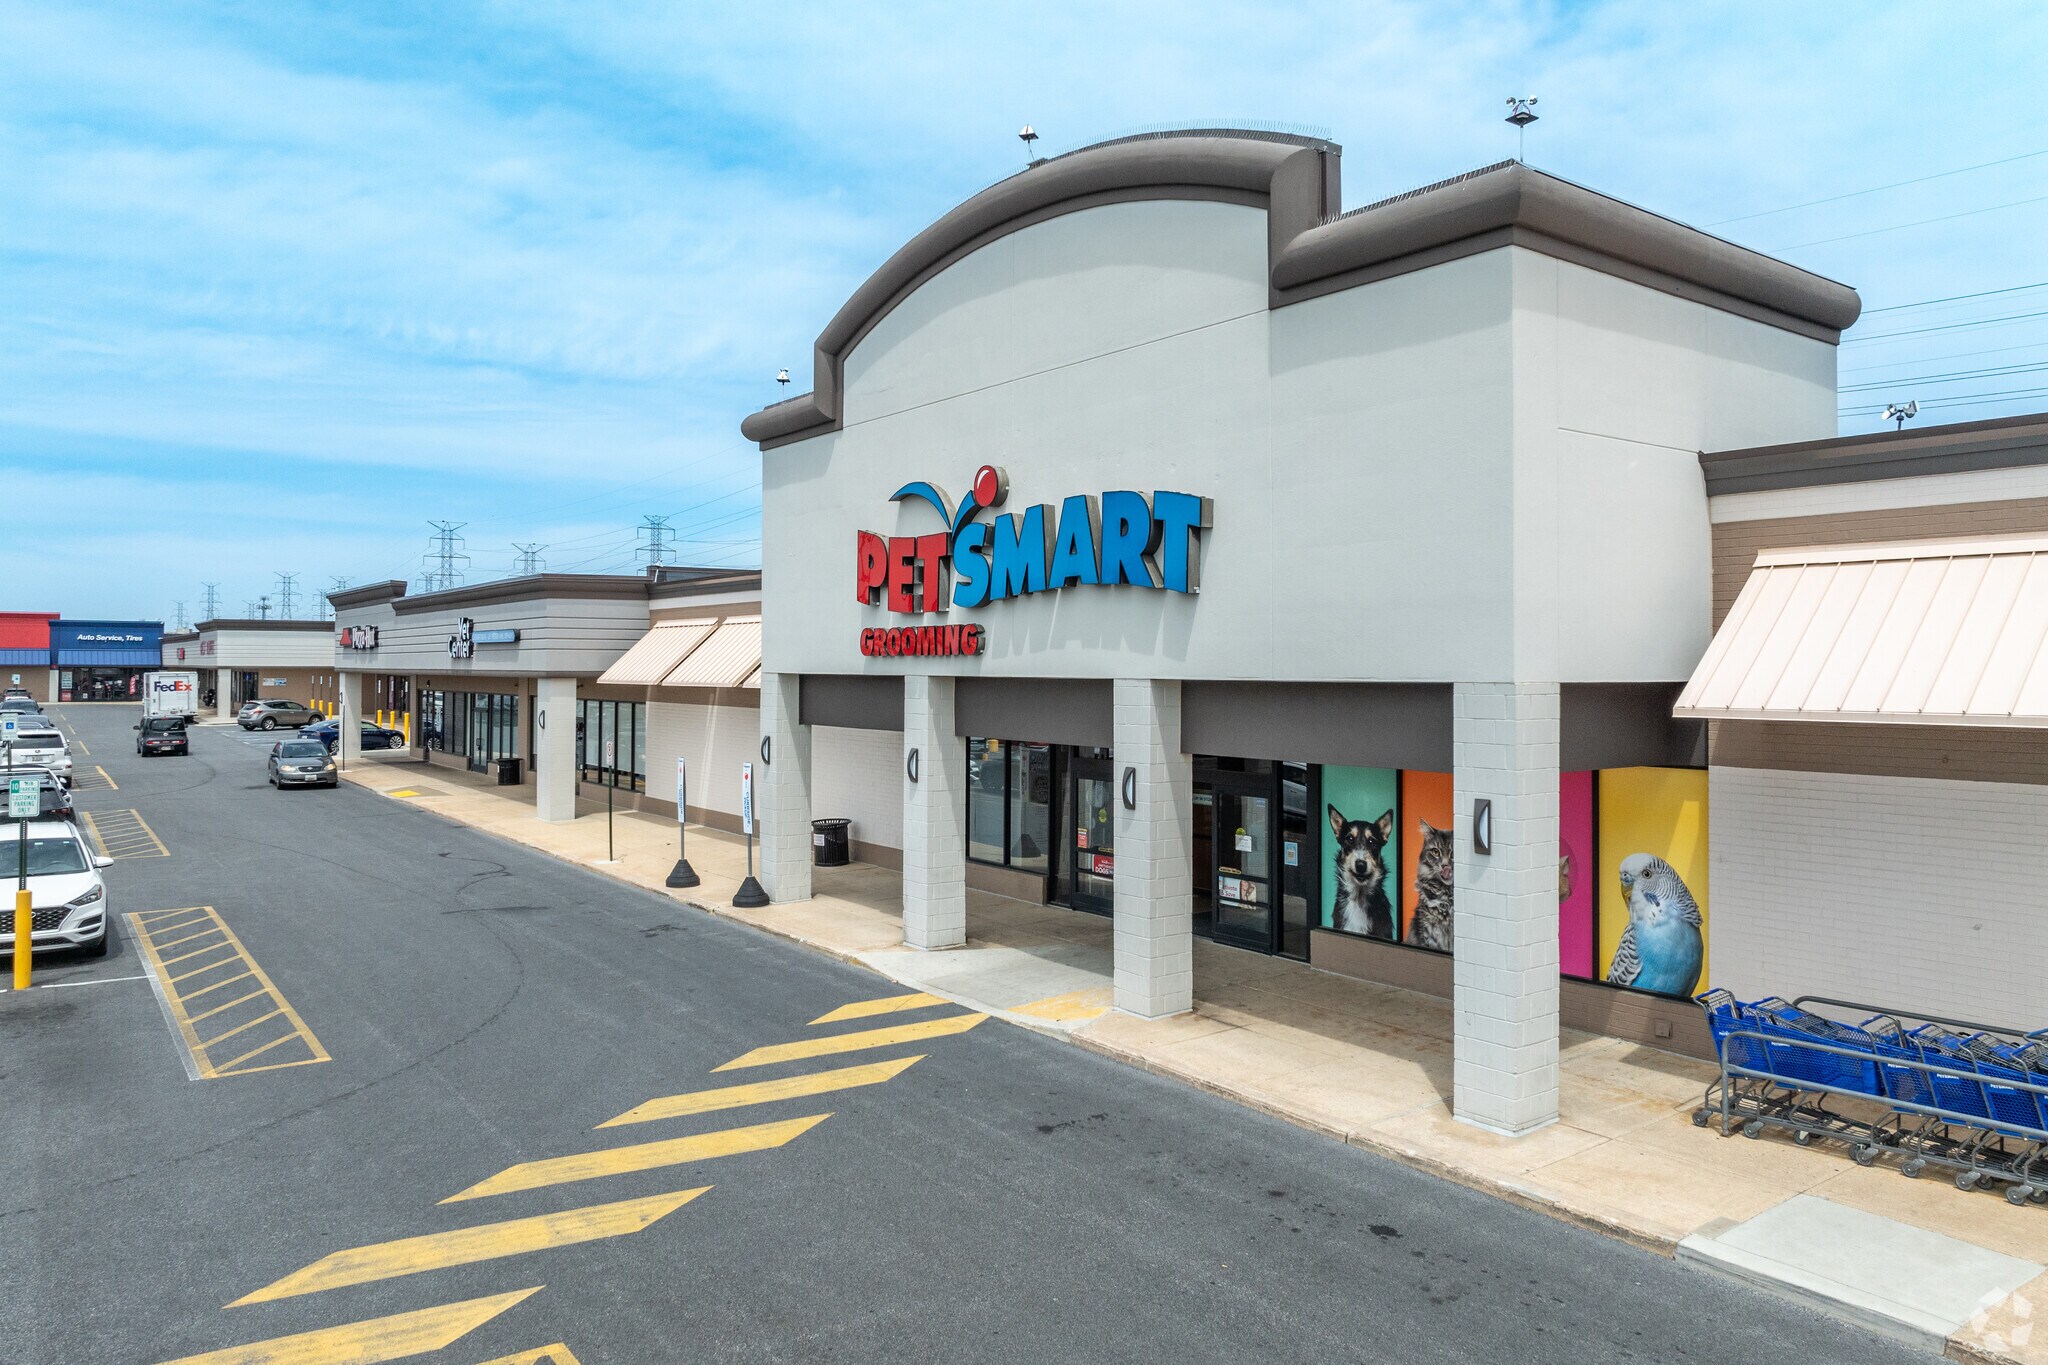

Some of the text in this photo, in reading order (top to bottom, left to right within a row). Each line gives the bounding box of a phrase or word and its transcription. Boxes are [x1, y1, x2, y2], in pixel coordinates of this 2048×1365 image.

[95, 634, 124, 642] Service,
[352, 626, 365, 649] Pizza
[860, 623, 981, 656] GROOMING
[448, 635, 471, 658] Center
[154, 681, 192, 692] FedEx
[12, 782, 19, 790] 10
